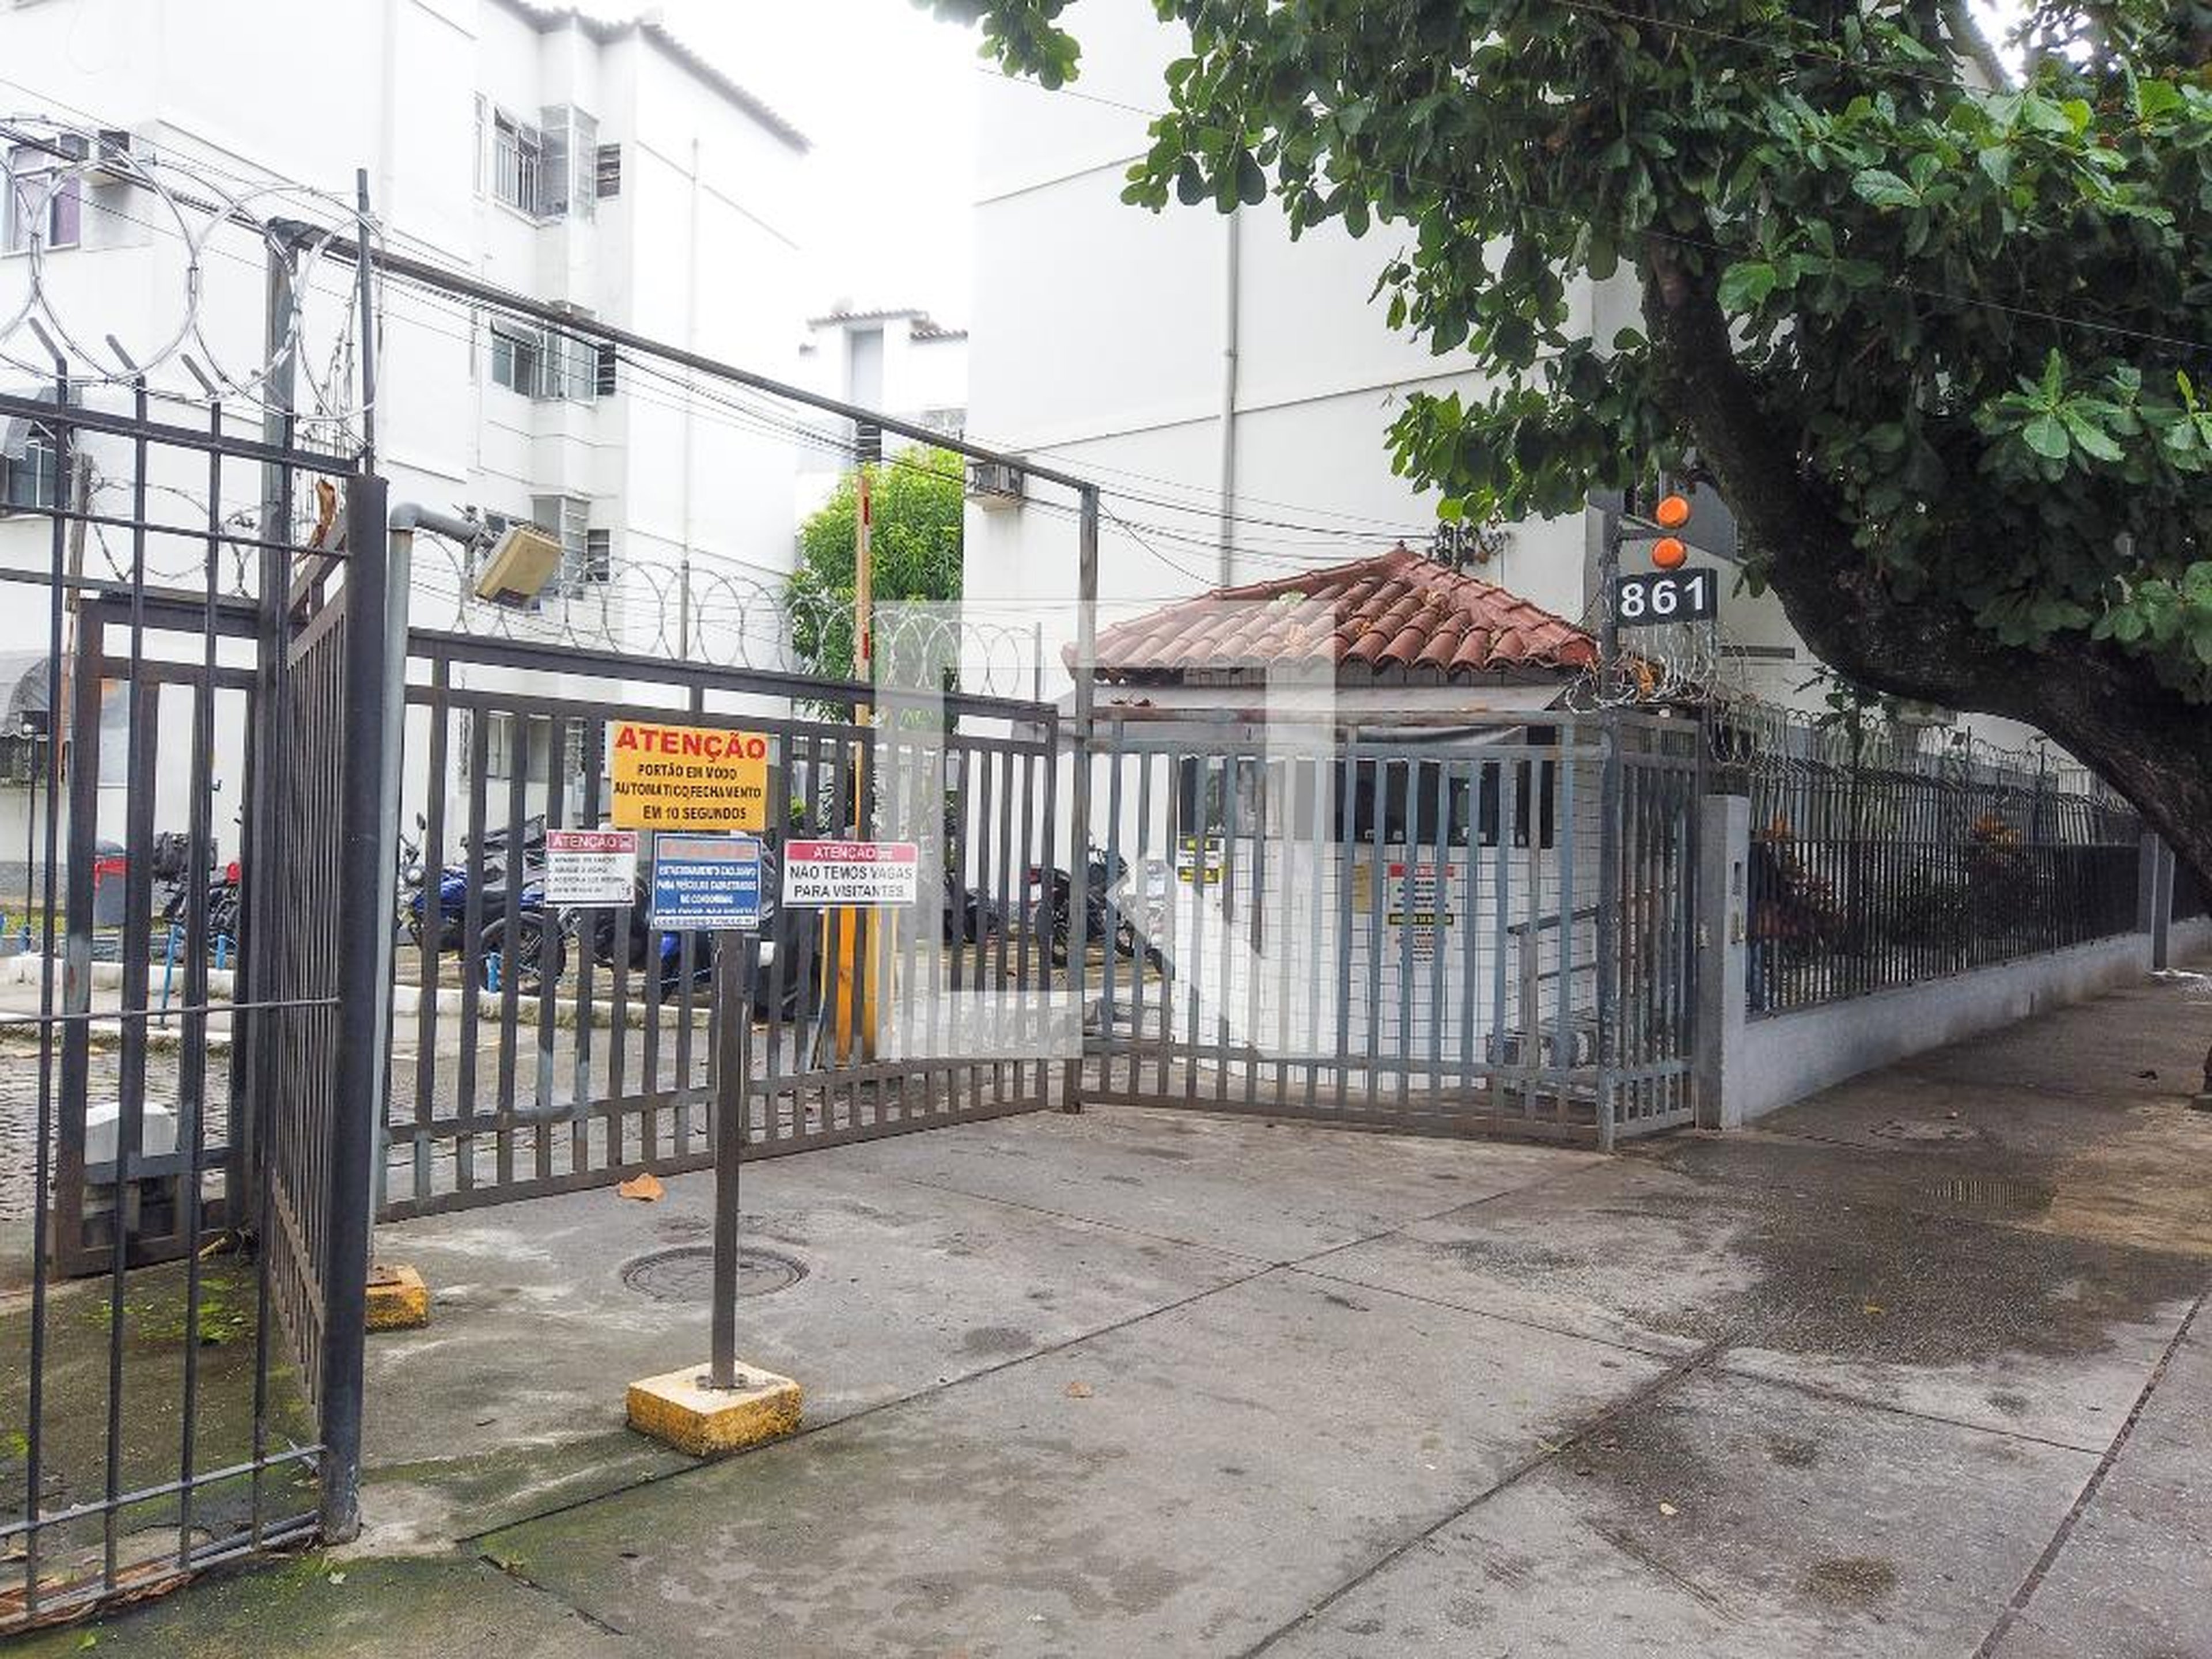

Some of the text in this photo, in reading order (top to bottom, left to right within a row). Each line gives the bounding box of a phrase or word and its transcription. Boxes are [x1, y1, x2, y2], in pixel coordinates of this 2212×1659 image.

[1620, 576, 1703, 617] 861
[615, 726, 766, 763] ATENÇÃO
[638, 763, 737, 780] PORTÃO EM MODO
[643, 805, 747, 820] EM 10 SEGUNDOS
[823, 865, 867, 880] TEMOS
[870, 866, 913, 880] VAGAS
[794, 885, 904, 897] PARA VISITANTES
